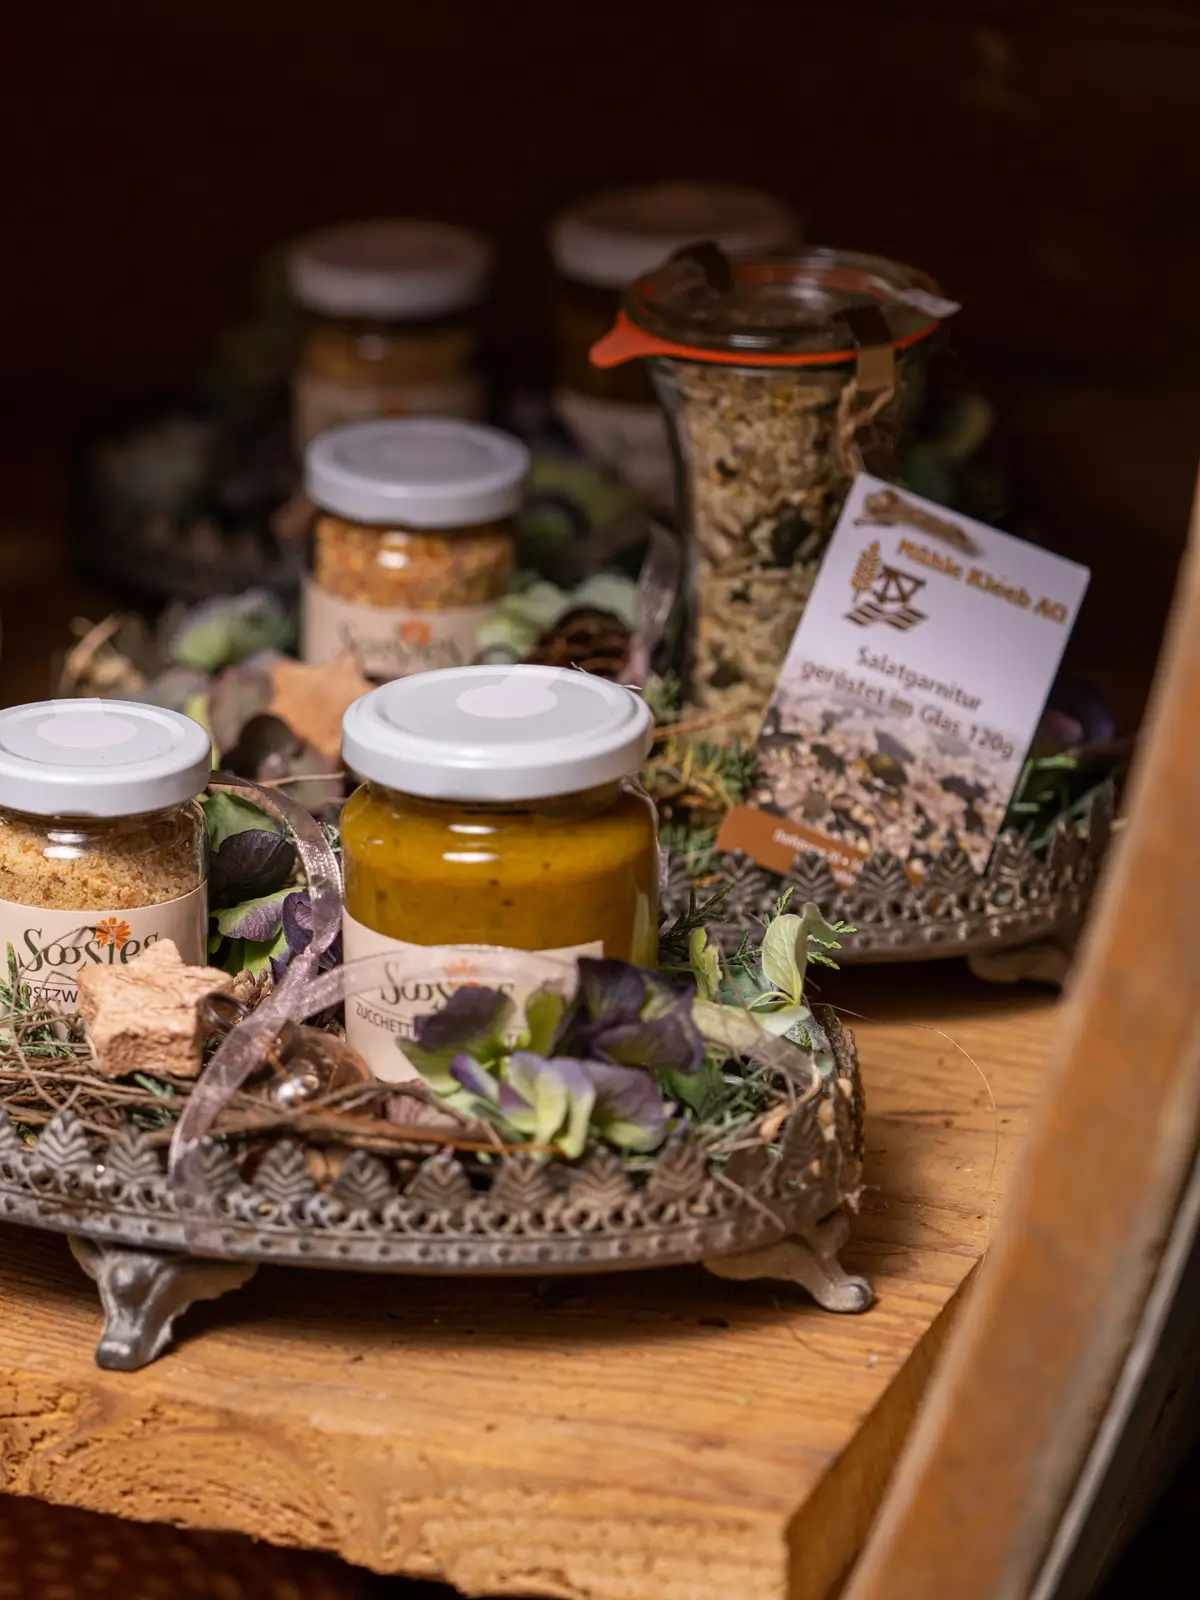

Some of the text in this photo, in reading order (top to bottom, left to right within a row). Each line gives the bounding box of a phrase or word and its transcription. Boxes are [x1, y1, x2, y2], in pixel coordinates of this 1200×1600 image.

[801, 660, 886, 705] geröstet
[888, 690, 915, 716] im
[968, 723, 1015, 761] 120g
[855, 645, 983, 714] Salatgarnitur
